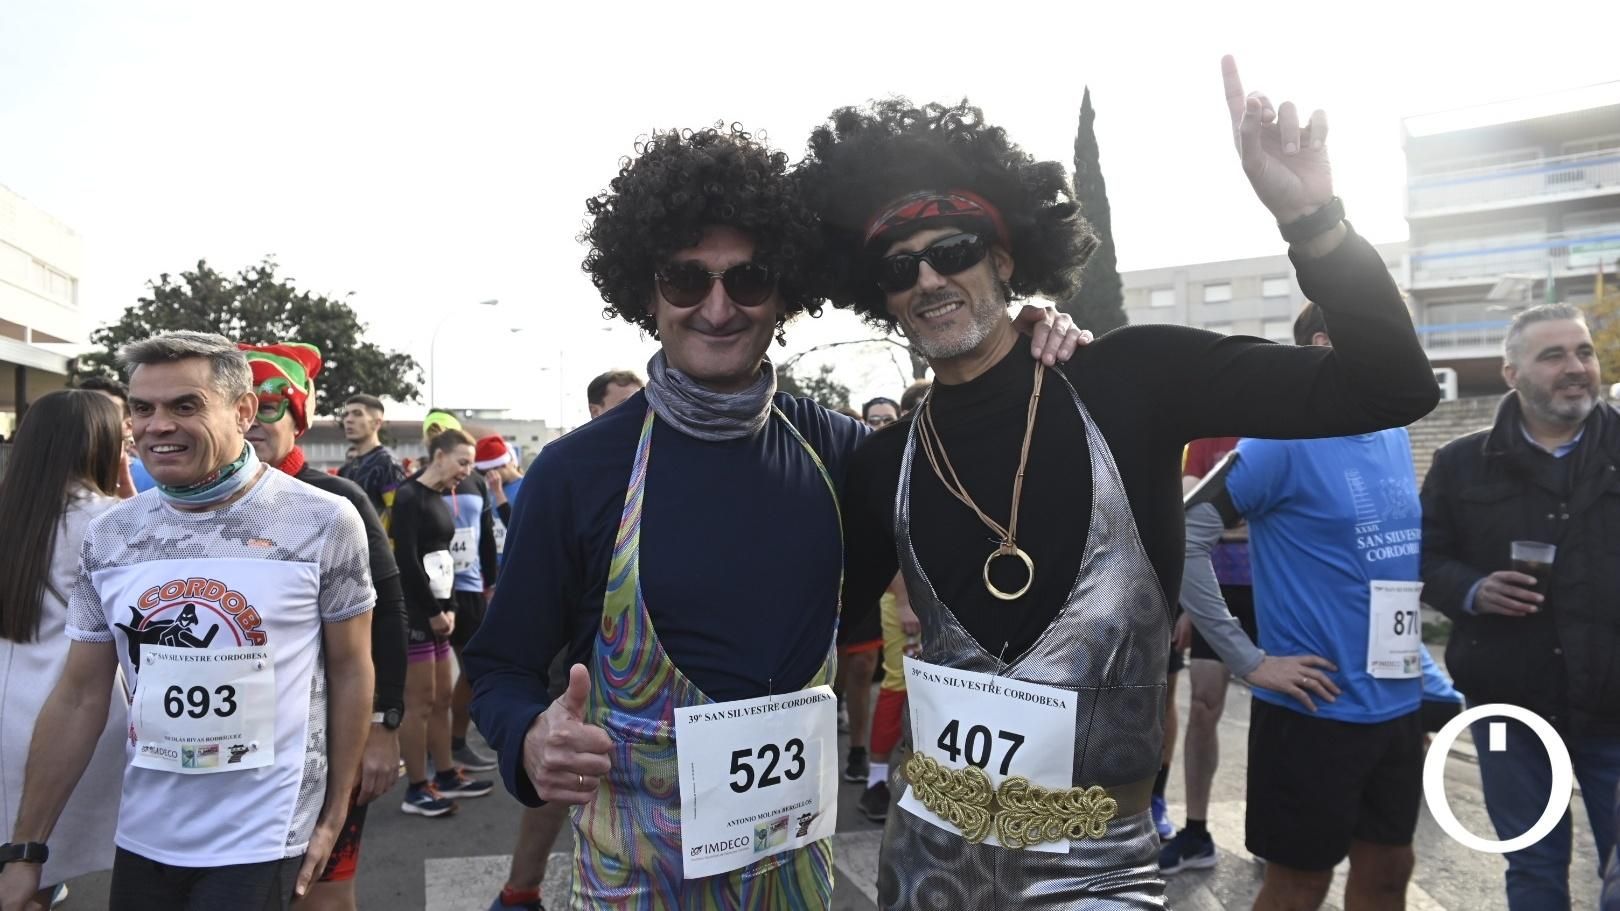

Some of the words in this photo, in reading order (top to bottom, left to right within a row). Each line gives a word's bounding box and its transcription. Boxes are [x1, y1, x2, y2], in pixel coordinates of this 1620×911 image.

[1357, 532, 1384, 549] SAN
[157, 652, 168, 661] SAN
[168, 652, 211, 663] SILVESTRE
[213, 652, 267, 663] CORDOBESA
[164, 685, 237, 719] 693
[922, 673, 941, 684] SAN
[943, 676, 1002, 696] SILVESTRE
[1004, 687, 1066, 709] CORDOBESA
[705, 711, 725, 722] SAN
[727, 702, 780, 719] SILVESTRE
[781, 693, 831, 710] CORDOBESA
[937, 719, 1025, 776] 407
[729, 737, 806, 793] 523
[726, 815, 757, 828] ANTONIO
[757, 808, 781, 822] MOLINA
[704, 835, 750, 855] IMDECO
